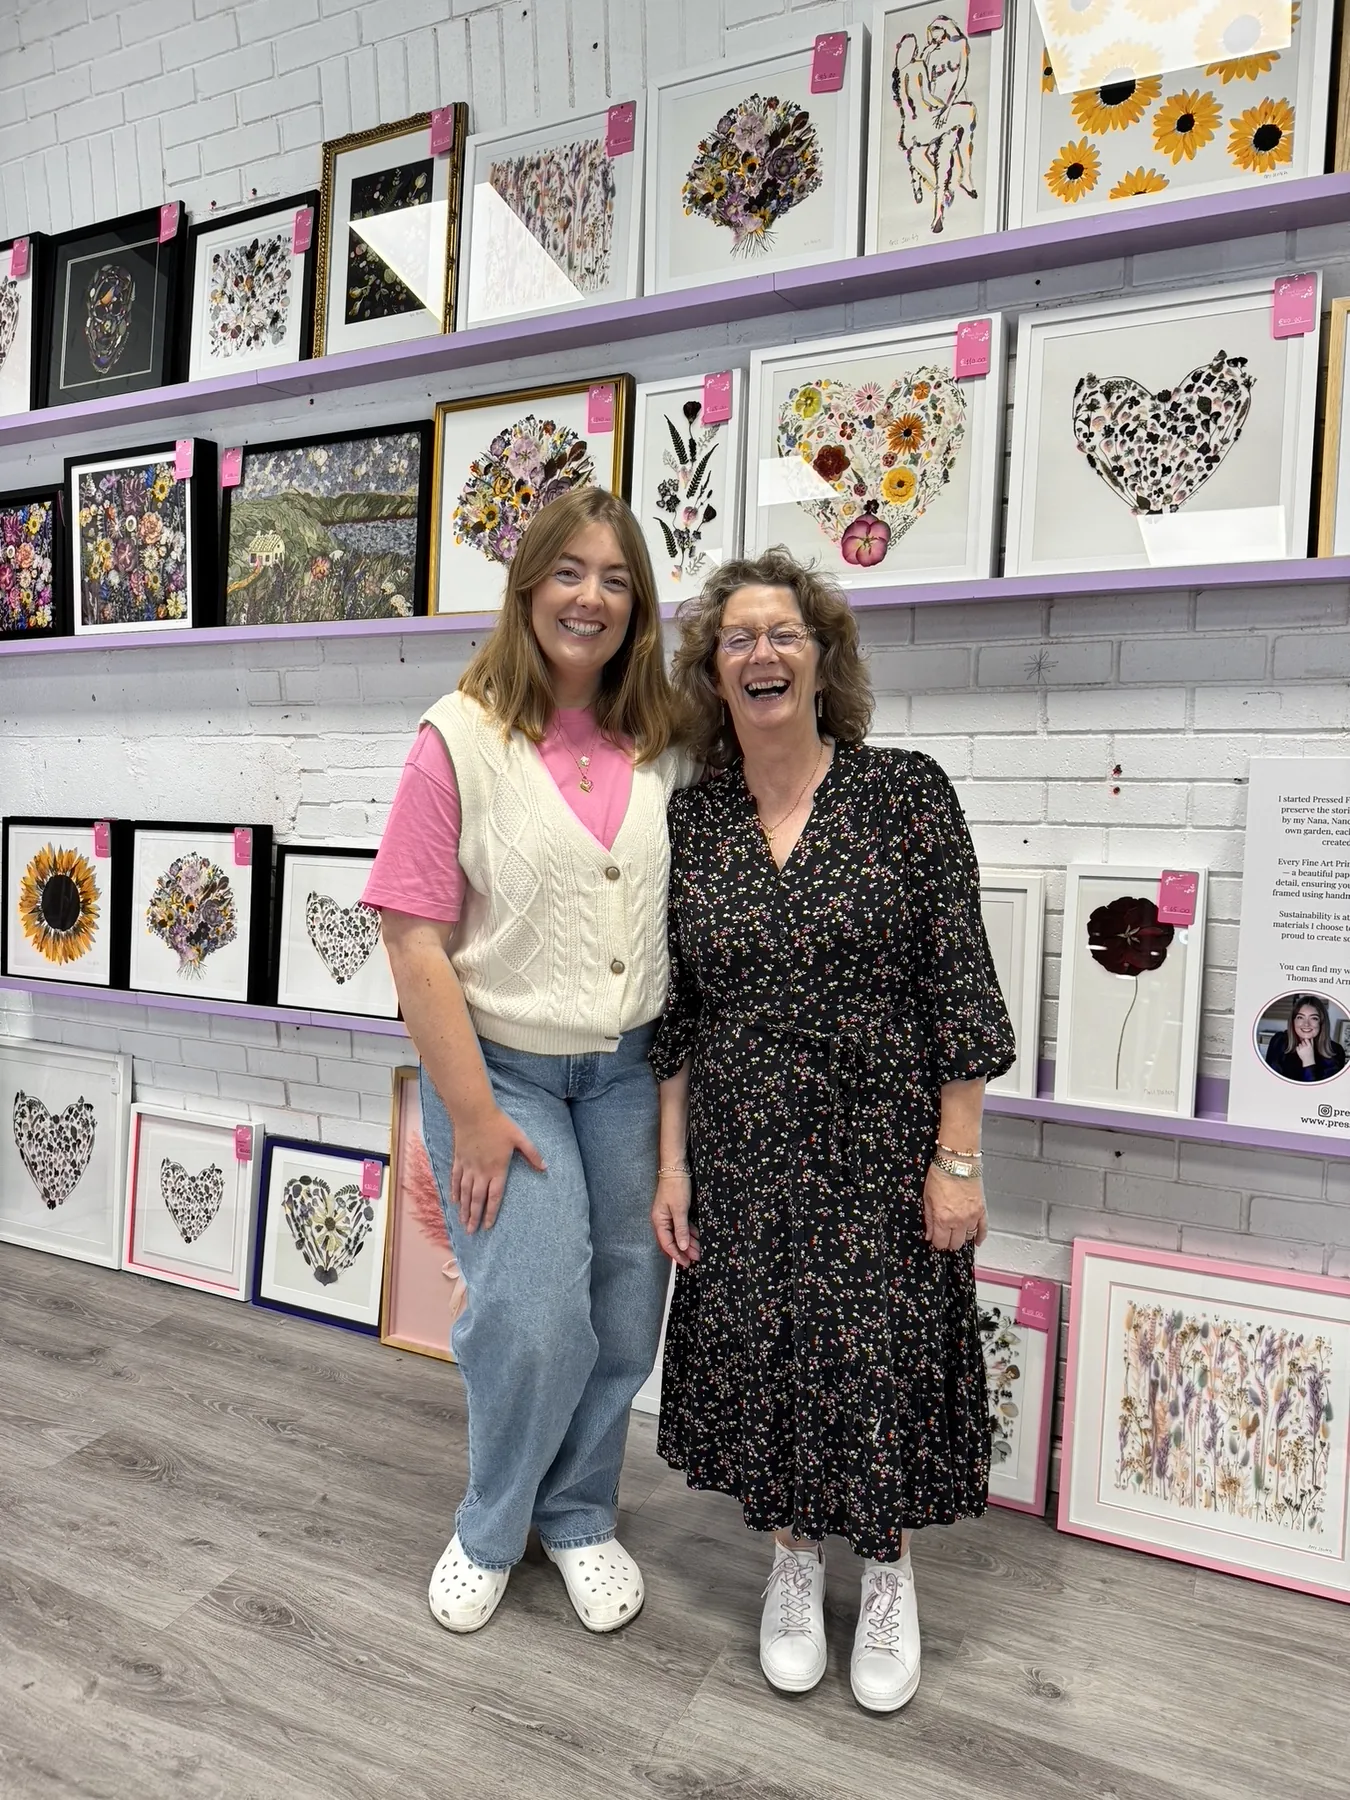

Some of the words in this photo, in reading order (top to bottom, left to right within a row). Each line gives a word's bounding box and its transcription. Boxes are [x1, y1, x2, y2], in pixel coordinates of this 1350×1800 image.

[1282, 816, 1291, 824] by
[1278, 858, 1300, 867] Every
[1298, 869, 1333, 877] beautiful
[1301, 881, 1336, 890] ensuring
[1272, 889, 1300, 897] framed
[1302, 891, 1324, 899] using
[1279, 910, 1332, 921] Sustainability
[1316, 923, 1344, 931] choose
[1312, 964, 1328, 973] find
[1286, 974, 1317, 983] Thomas
[1300, 1117, 1350, 1128] www.pres
